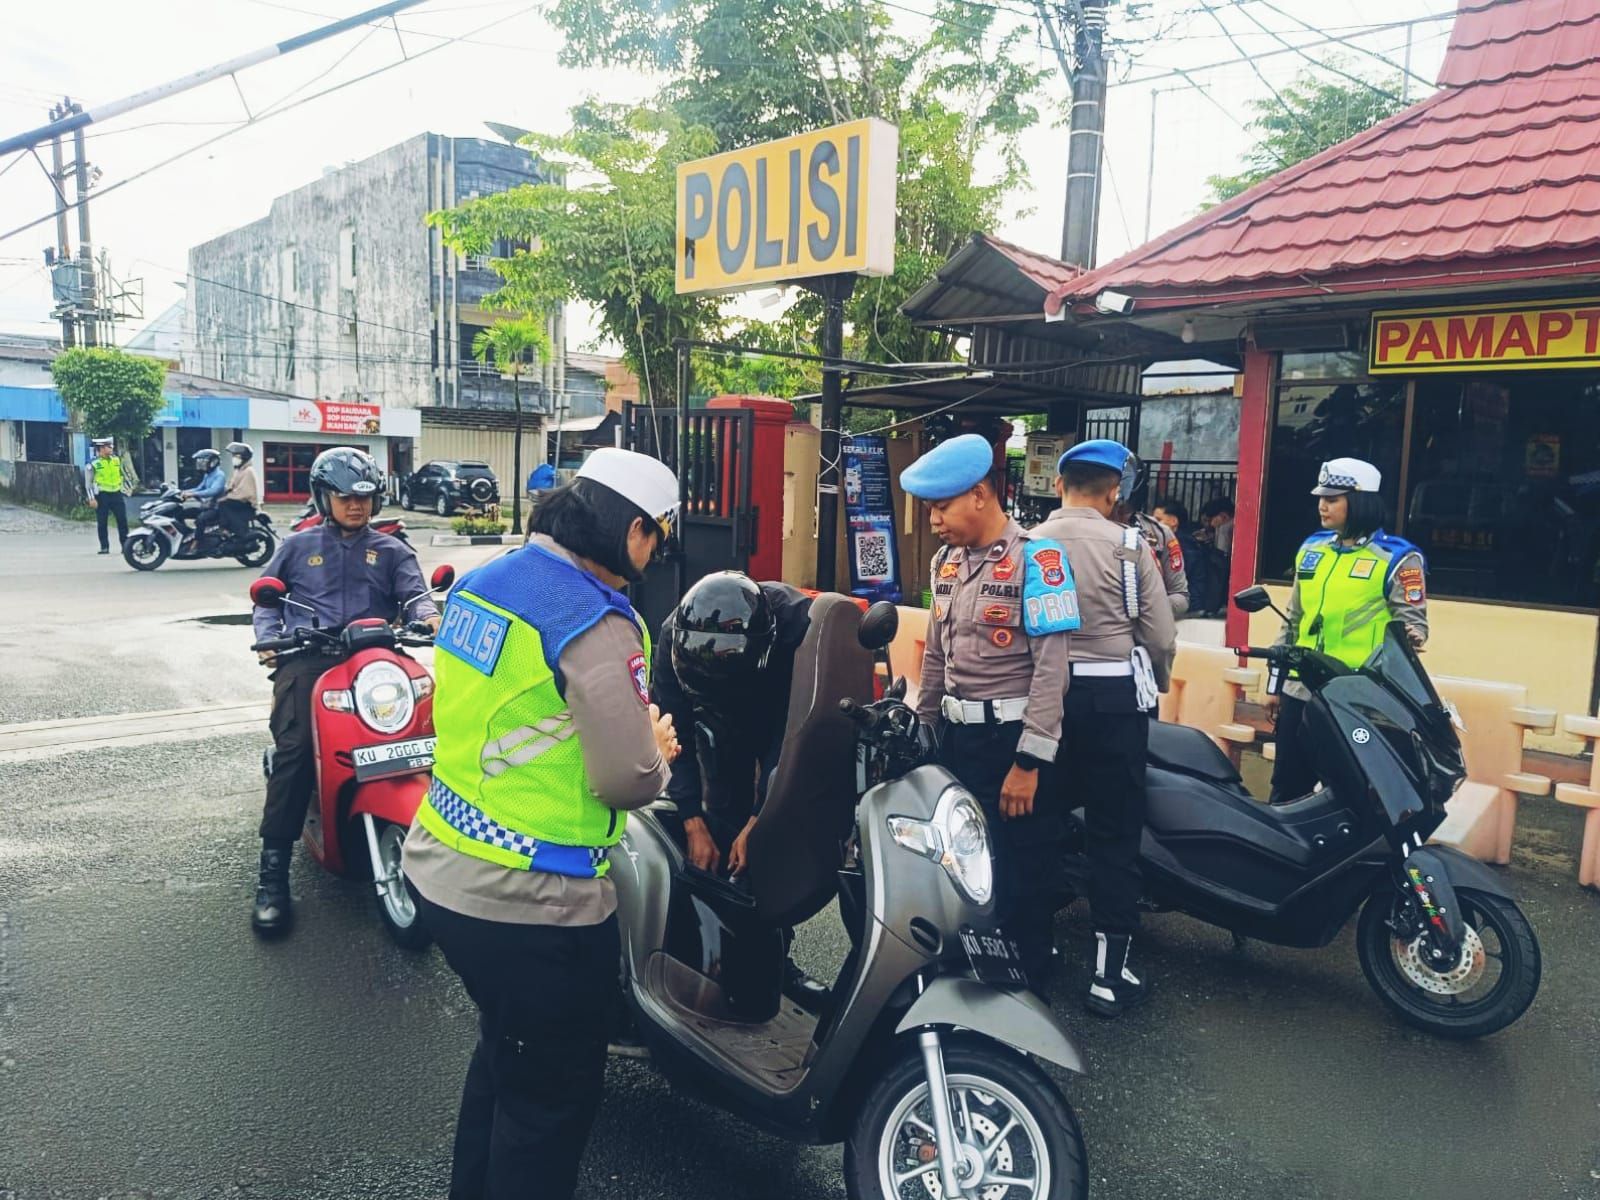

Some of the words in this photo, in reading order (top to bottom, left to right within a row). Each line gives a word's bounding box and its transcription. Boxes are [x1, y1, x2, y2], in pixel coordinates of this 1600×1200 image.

[684, 135, 860, 280] POLISI
[1378, 309, 1600, 362] PAMAPT
[980, 583, 1020, 599] POLRI
[1026, 590, 1080, 628] PRO
[441, 603, 504, 665] POLISI
[357, 749, 377, 764] KU
[960, 933, 982, 955] KU
